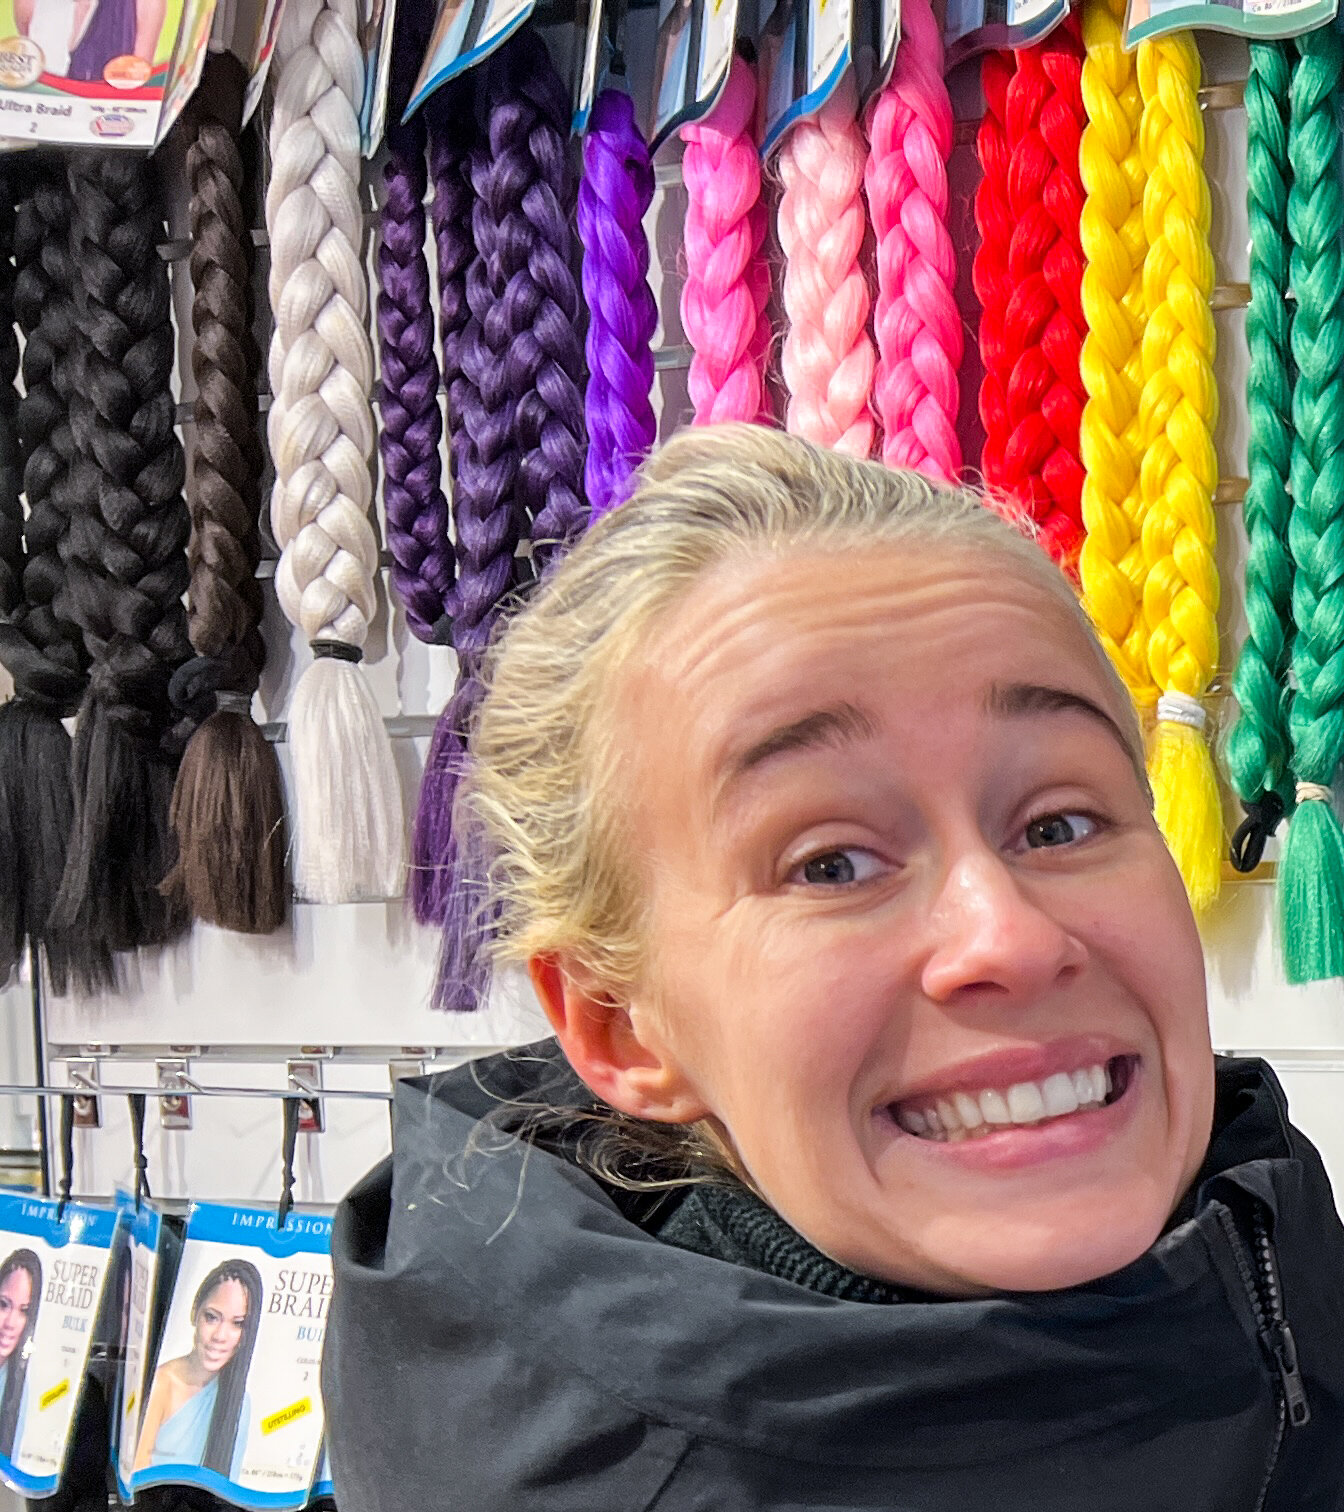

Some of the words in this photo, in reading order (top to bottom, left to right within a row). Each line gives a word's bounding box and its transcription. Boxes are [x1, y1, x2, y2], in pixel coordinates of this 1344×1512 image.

[35, 102, 73, 117] Braid
[231, 1212, 333, 1236] IMPRSSION
[50, 1260, 98, 1287] SUPER
[274, 1269, 335, 1296] SUPE
[45, 1281, 93, 1309] BRAID
[267, 1292, 328, 1320] BRAI
[61, 1315, 89, 1332] BULK
